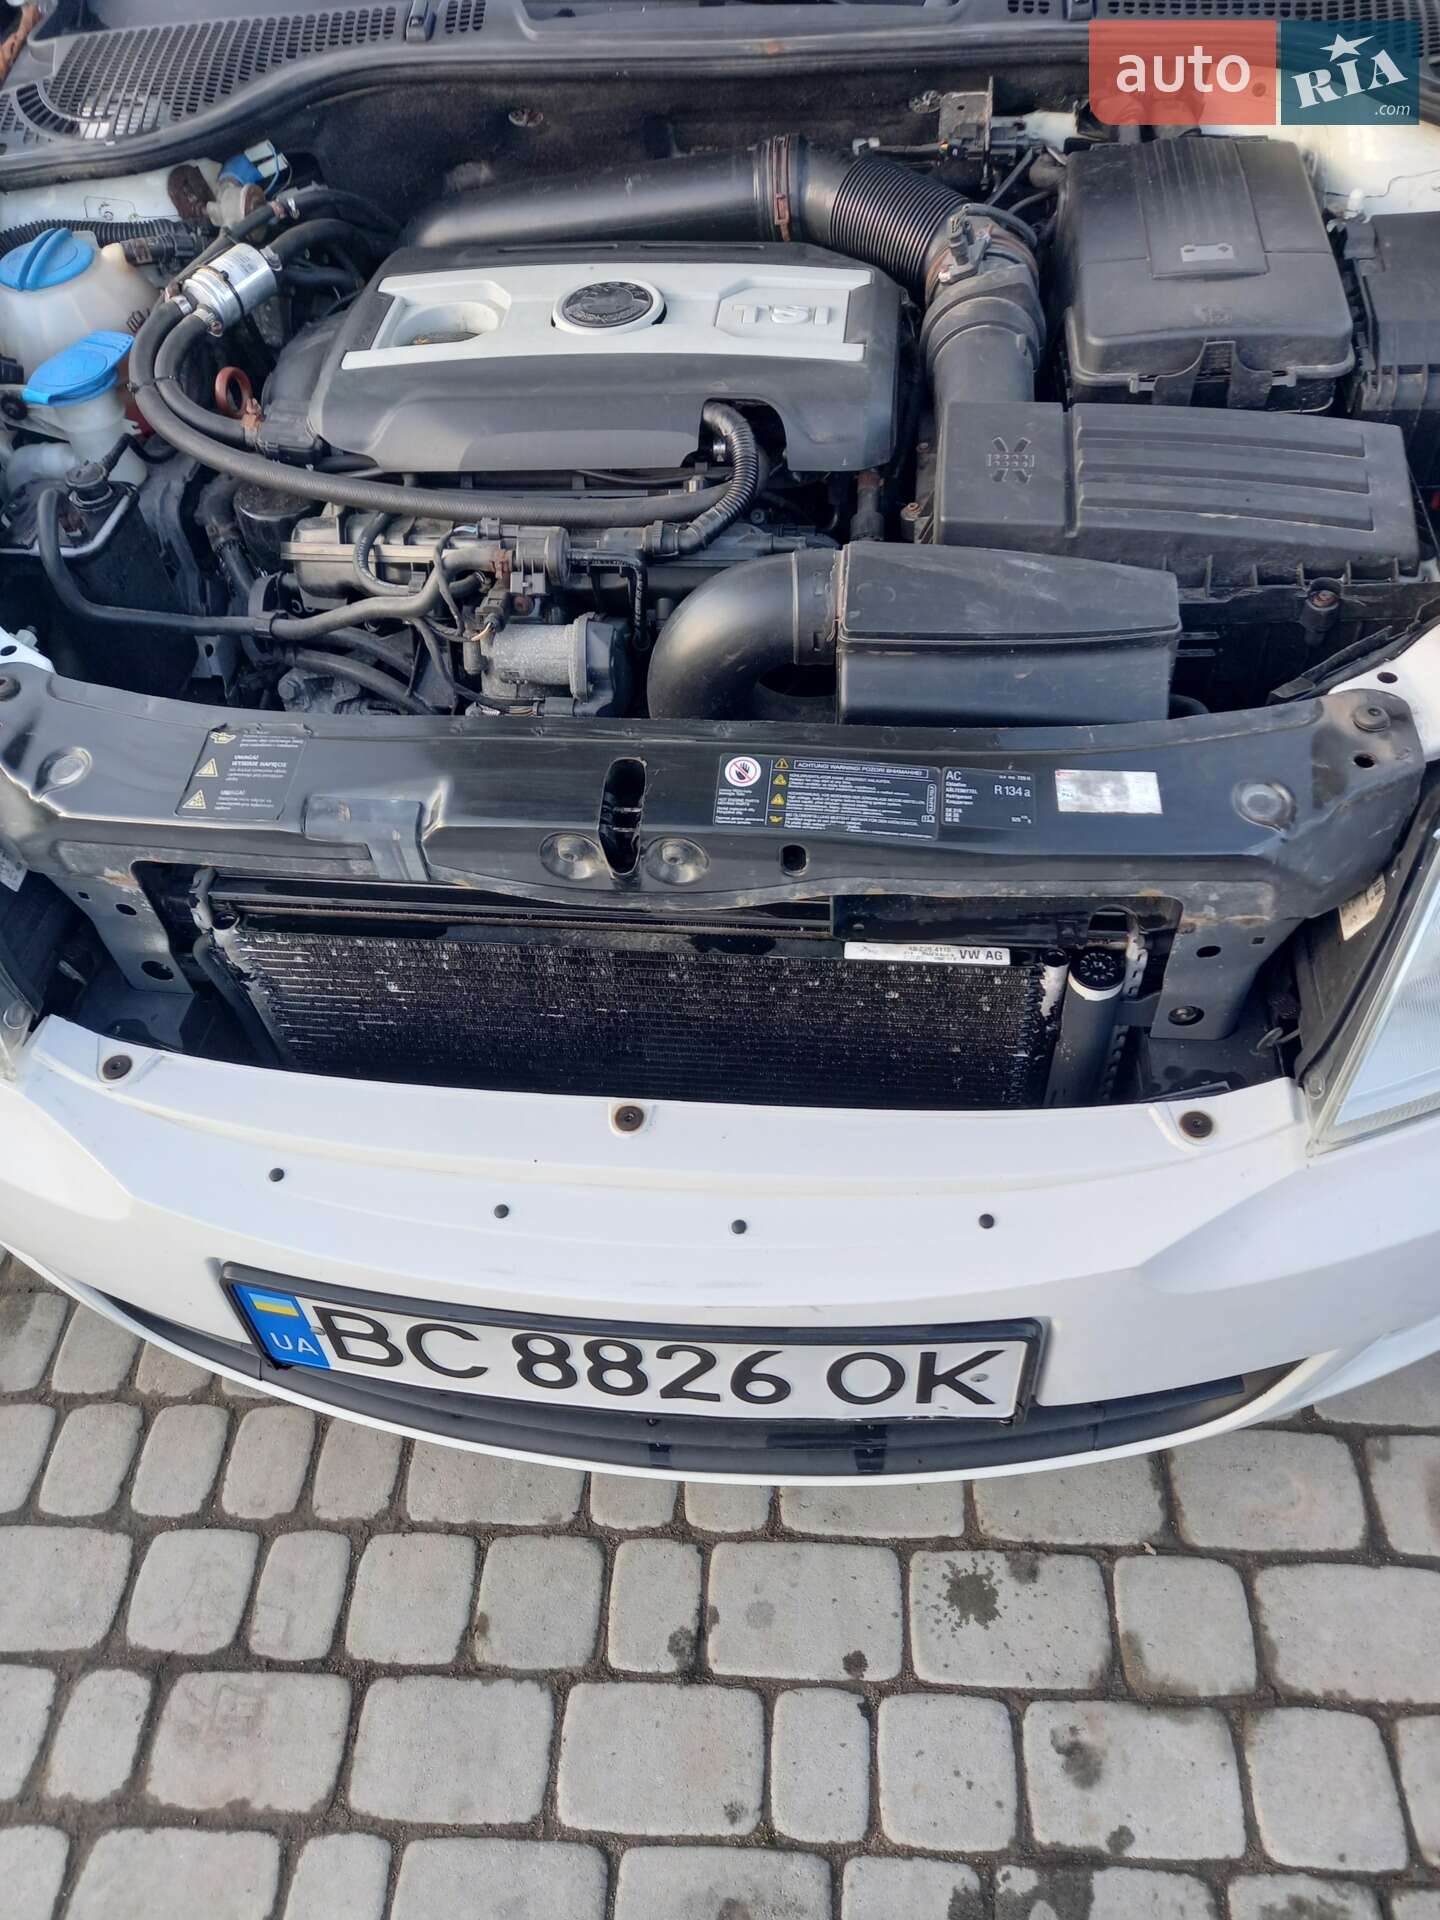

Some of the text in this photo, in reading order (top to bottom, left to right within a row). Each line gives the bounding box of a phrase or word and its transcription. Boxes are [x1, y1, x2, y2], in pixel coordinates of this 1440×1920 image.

[731, 303, 832, 325] TSI
[946, 770, 962, 781] AC
[994, 784, 1032, 797] R 134 a
[959, 949, 981, 960] VW
[985, 951, 1003, 961] AG
[269, 1332, 319, 1357] UA
[313, 1306, 1006, 1405] BC 8826 OK
